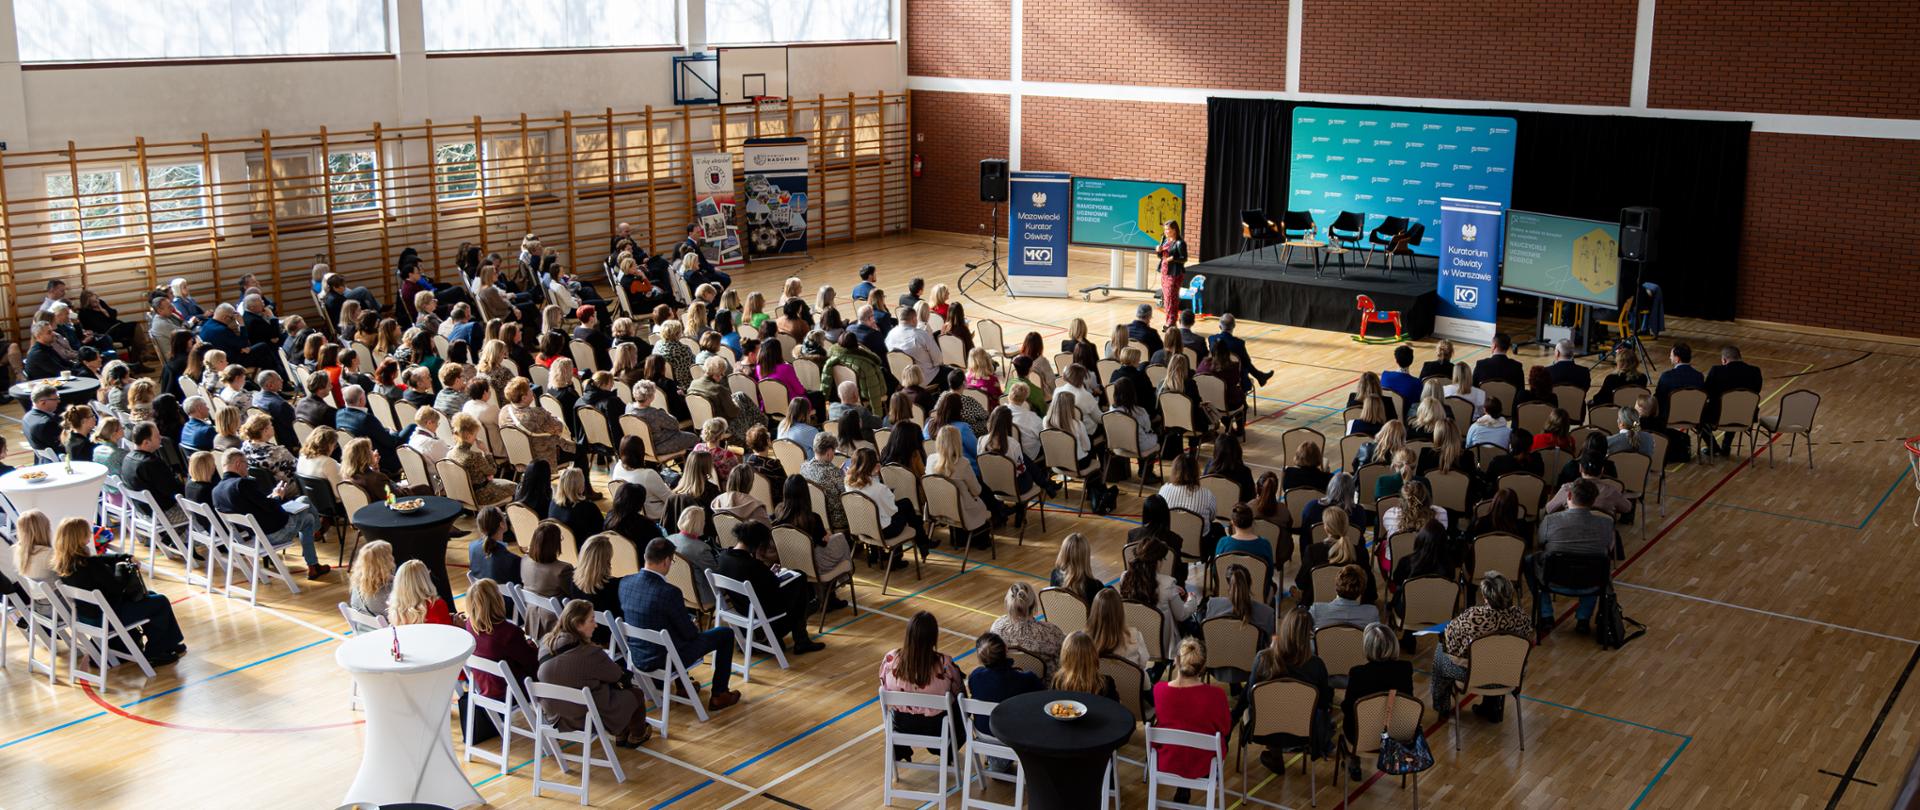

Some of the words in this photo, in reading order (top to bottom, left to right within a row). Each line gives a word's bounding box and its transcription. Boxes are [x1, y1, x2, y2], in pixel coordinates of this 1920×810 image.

[1076, 203, 1113, 211] NAUCZYCIELE
[1017, 211, 1061, 221] Mazowiecki
[1025, 222, 1053, 230] Kurator
[1024, 231, 1053, 242] Oświaty
[1025, 249, 1051, 261] MKO
[1448, 245, 1489, 258] Kuratorium
[1453, 257, 1483, 270] Oświaty
[1452, 269, 1492, 281] Warszawie
[1456, 288, 1476, 302] KO
